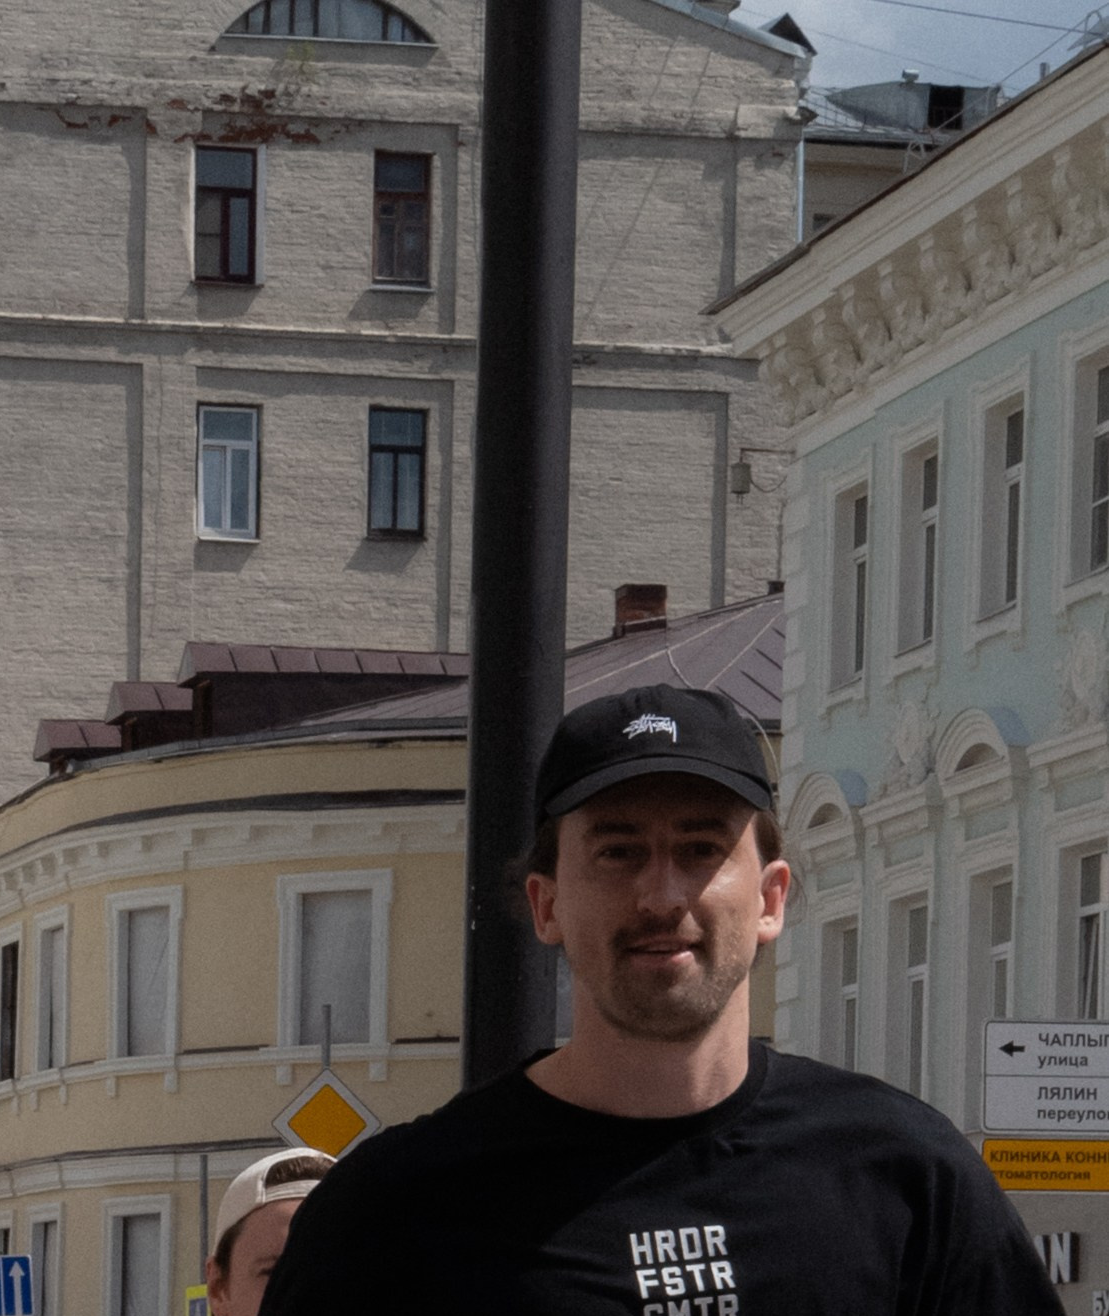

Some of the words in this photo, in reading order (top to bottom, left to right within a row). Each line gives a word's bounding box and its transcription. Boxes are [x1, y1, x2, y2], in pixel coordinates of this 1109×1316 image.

[1037, 1055, 1089, 1069] улица
[1037, 1086, 1098, 1101] ЛЯЛИН
[989, 1150, 1061, 1163] КЛИНИКА
[1065, 1151, 1109, 1164] КОНН
[629, 1224, 728, 1266] HRDR
[635, 1260, 737, 1299] FSTR
